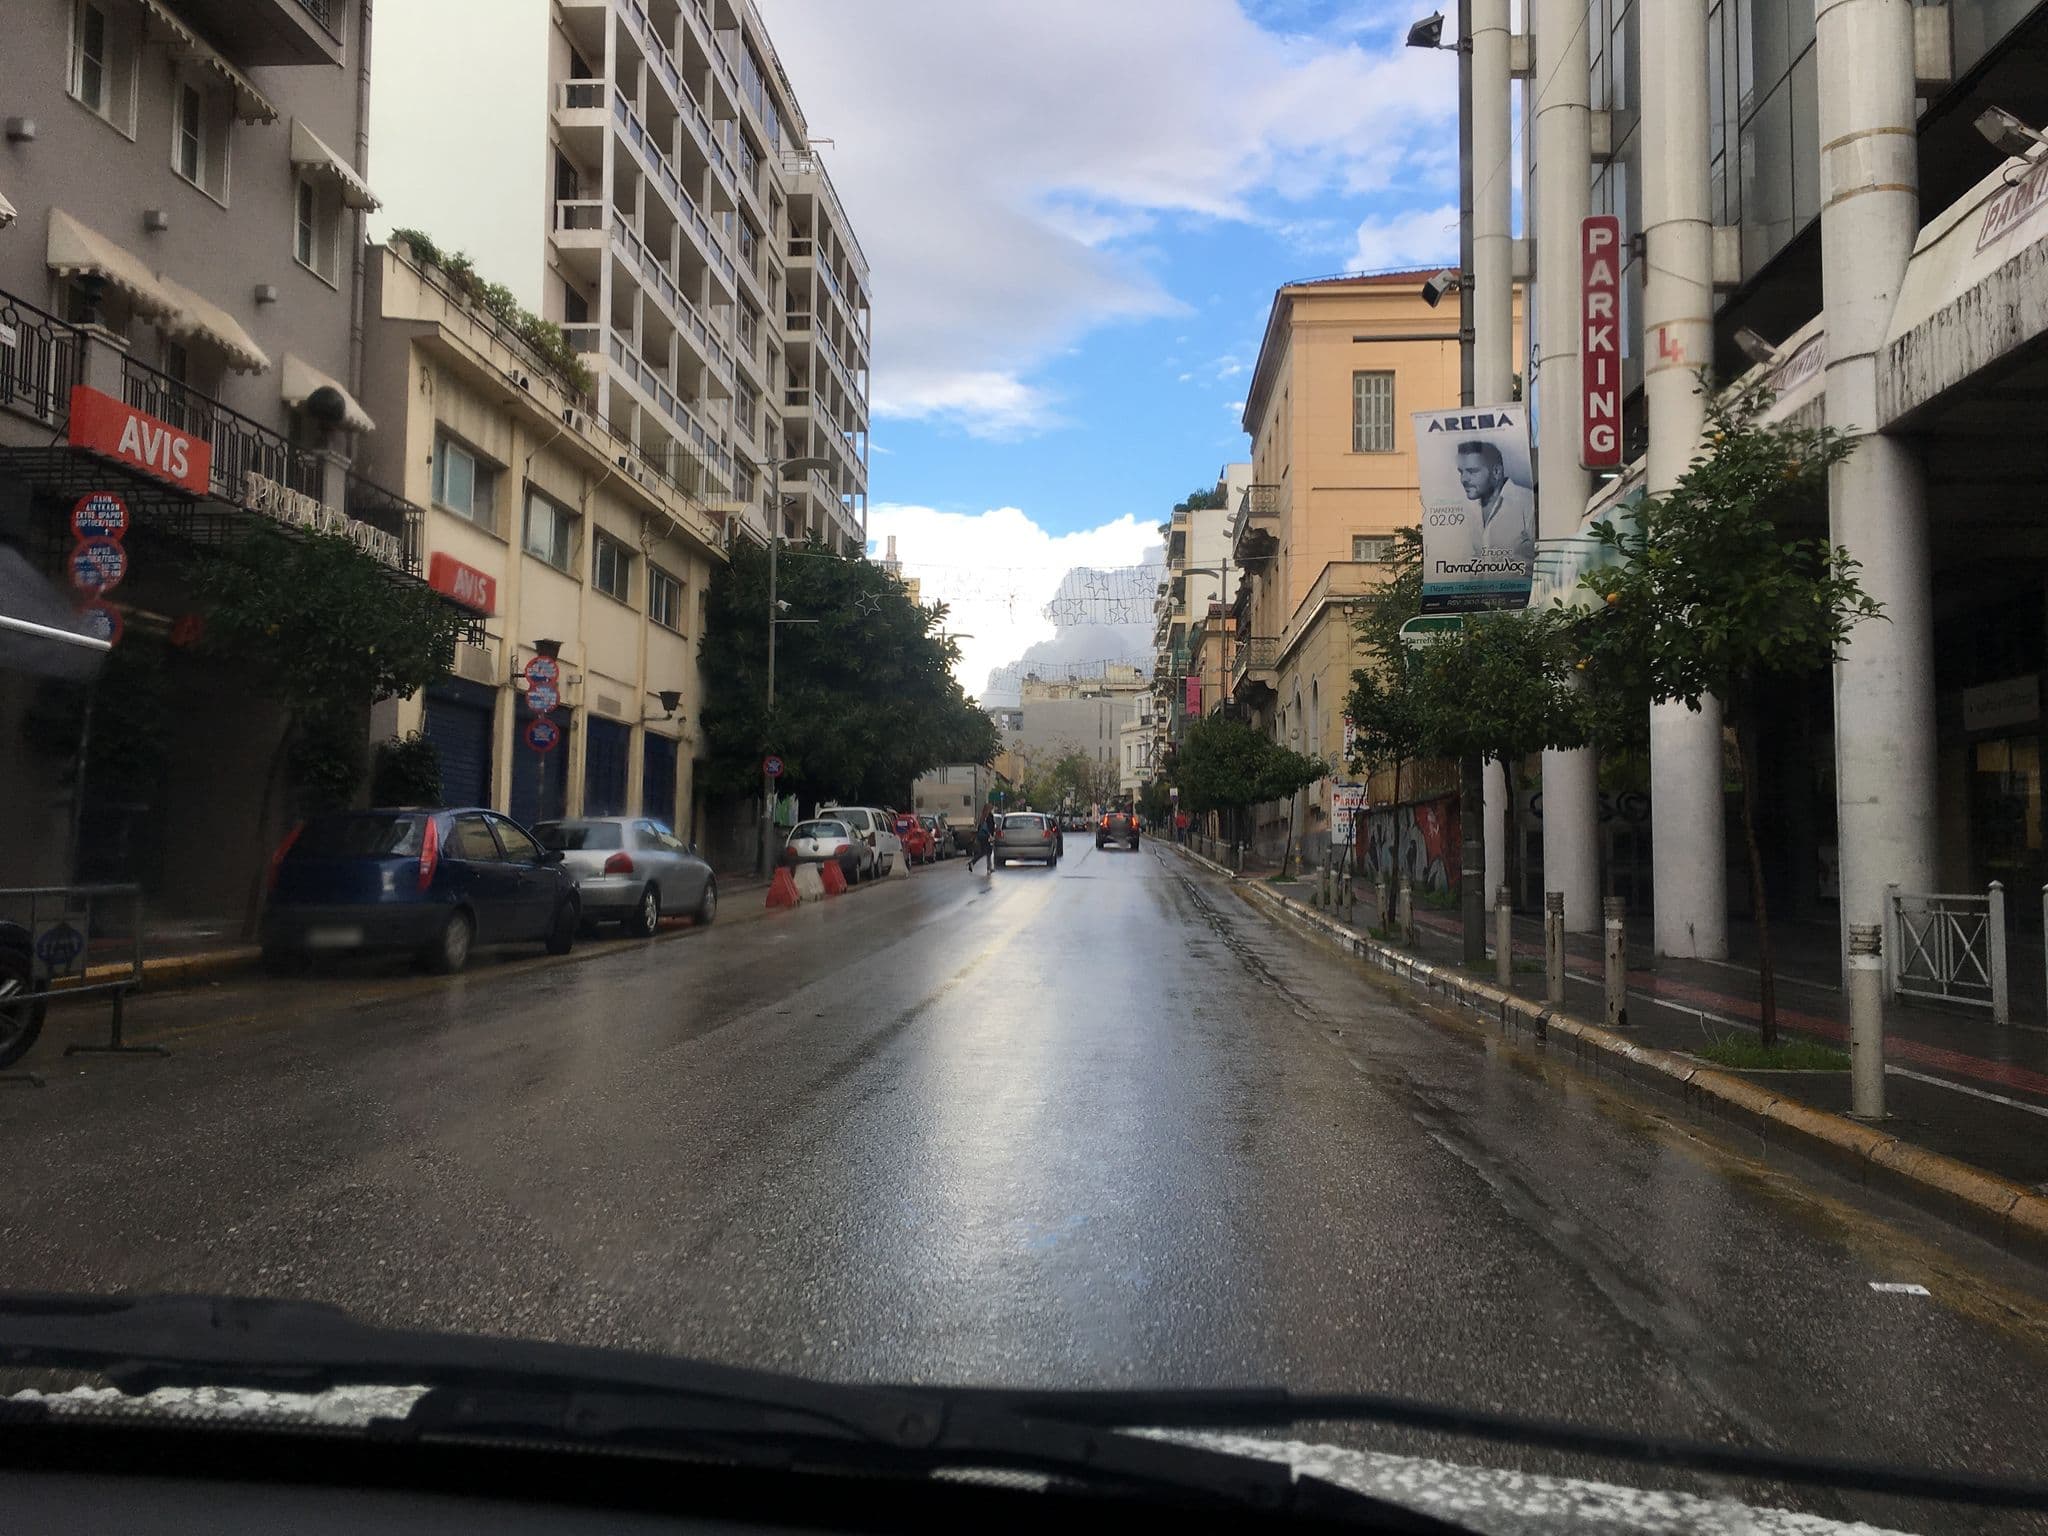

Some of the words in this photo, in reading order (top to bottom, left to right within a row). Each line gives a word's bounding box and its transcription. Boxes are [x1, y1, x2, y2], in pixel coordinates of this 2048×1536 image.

[1588, 228, 1615, 453] PARKING
[118, 415, 189, 478] AVIS
[1430, 513, 1465, 526] 02.09
[453, 567, 487, 605] AVIS
[1436, 558, 1525, 576] Πανταζόπουλος
